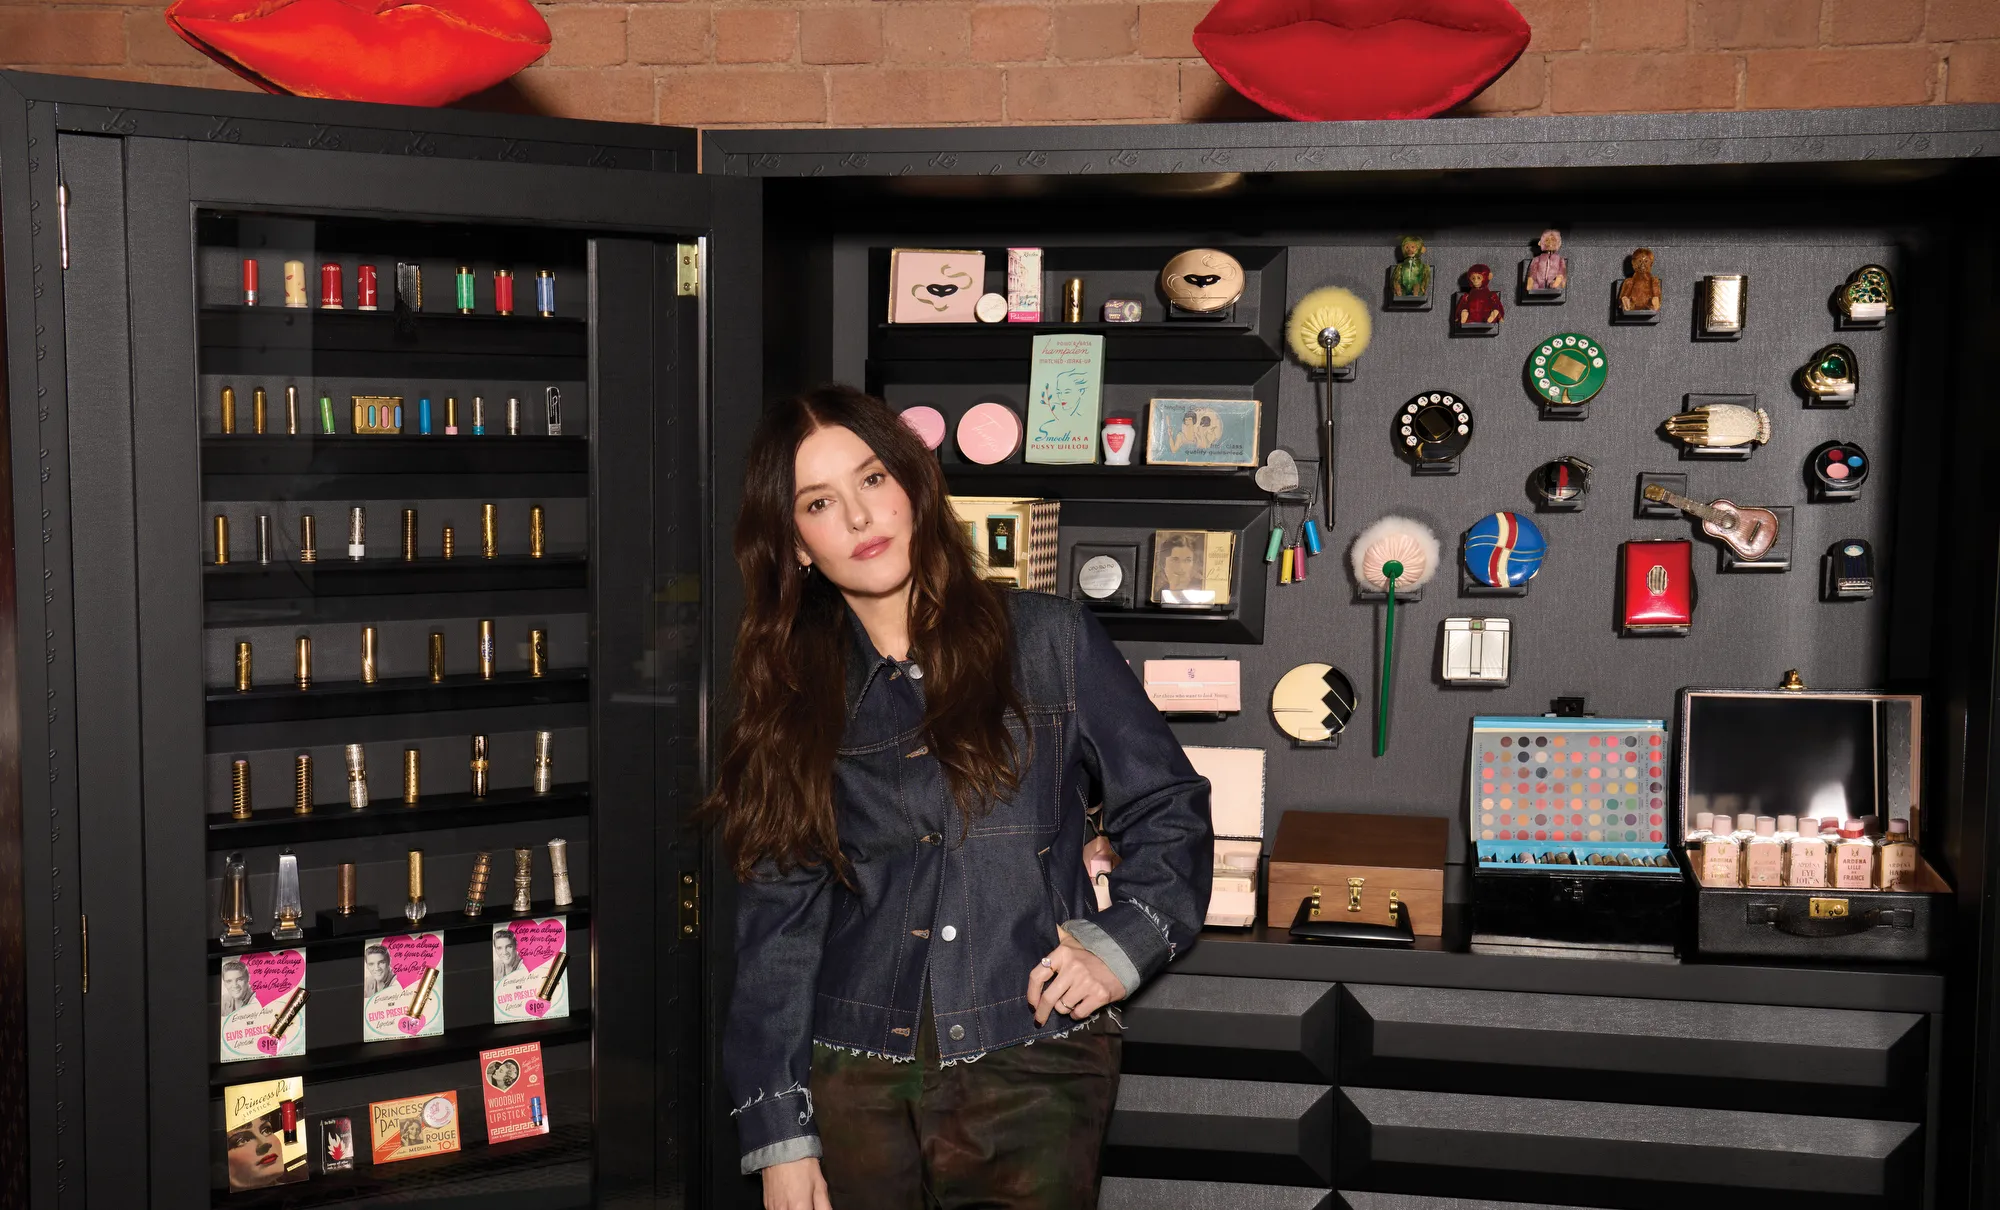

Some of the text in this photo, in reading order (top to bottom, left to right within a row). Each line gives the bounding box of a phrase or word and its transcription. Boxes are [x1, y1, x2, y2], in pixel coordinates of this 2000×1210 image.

[1041, 338, 1089, 358] hampden
[1034, 419, 1071, 442] Smooth
[540, 924, 563, 935] always
[415, 939, 440, 950] always
[529, 935, 545, 945] your
[276, 955, 302, 967] always
[404, 950, 421, 960] your
[263, 967, 281, 977] your
[497, 988, 537, 1004] ELVIS PRESLEY
[368, 1011, 385, 1022] ELVIS
[226, 1029, 243, 1042] ELVIS
[234, 1092, 275, 1116] Princess
[487, 1092, 525, 1109] WOODBURY
[242, 1101, 271, 1117] LIPSTICK
[374, 1102, 424, 1123] PRINCESS
[489, 1108, 526, 1124] LIPSTICK
[380, 1118, 400, 1137] PAT
[425, 1130, 456, 1143] ROUGE
[408, 1145, 432, 1153] MEDIUM
